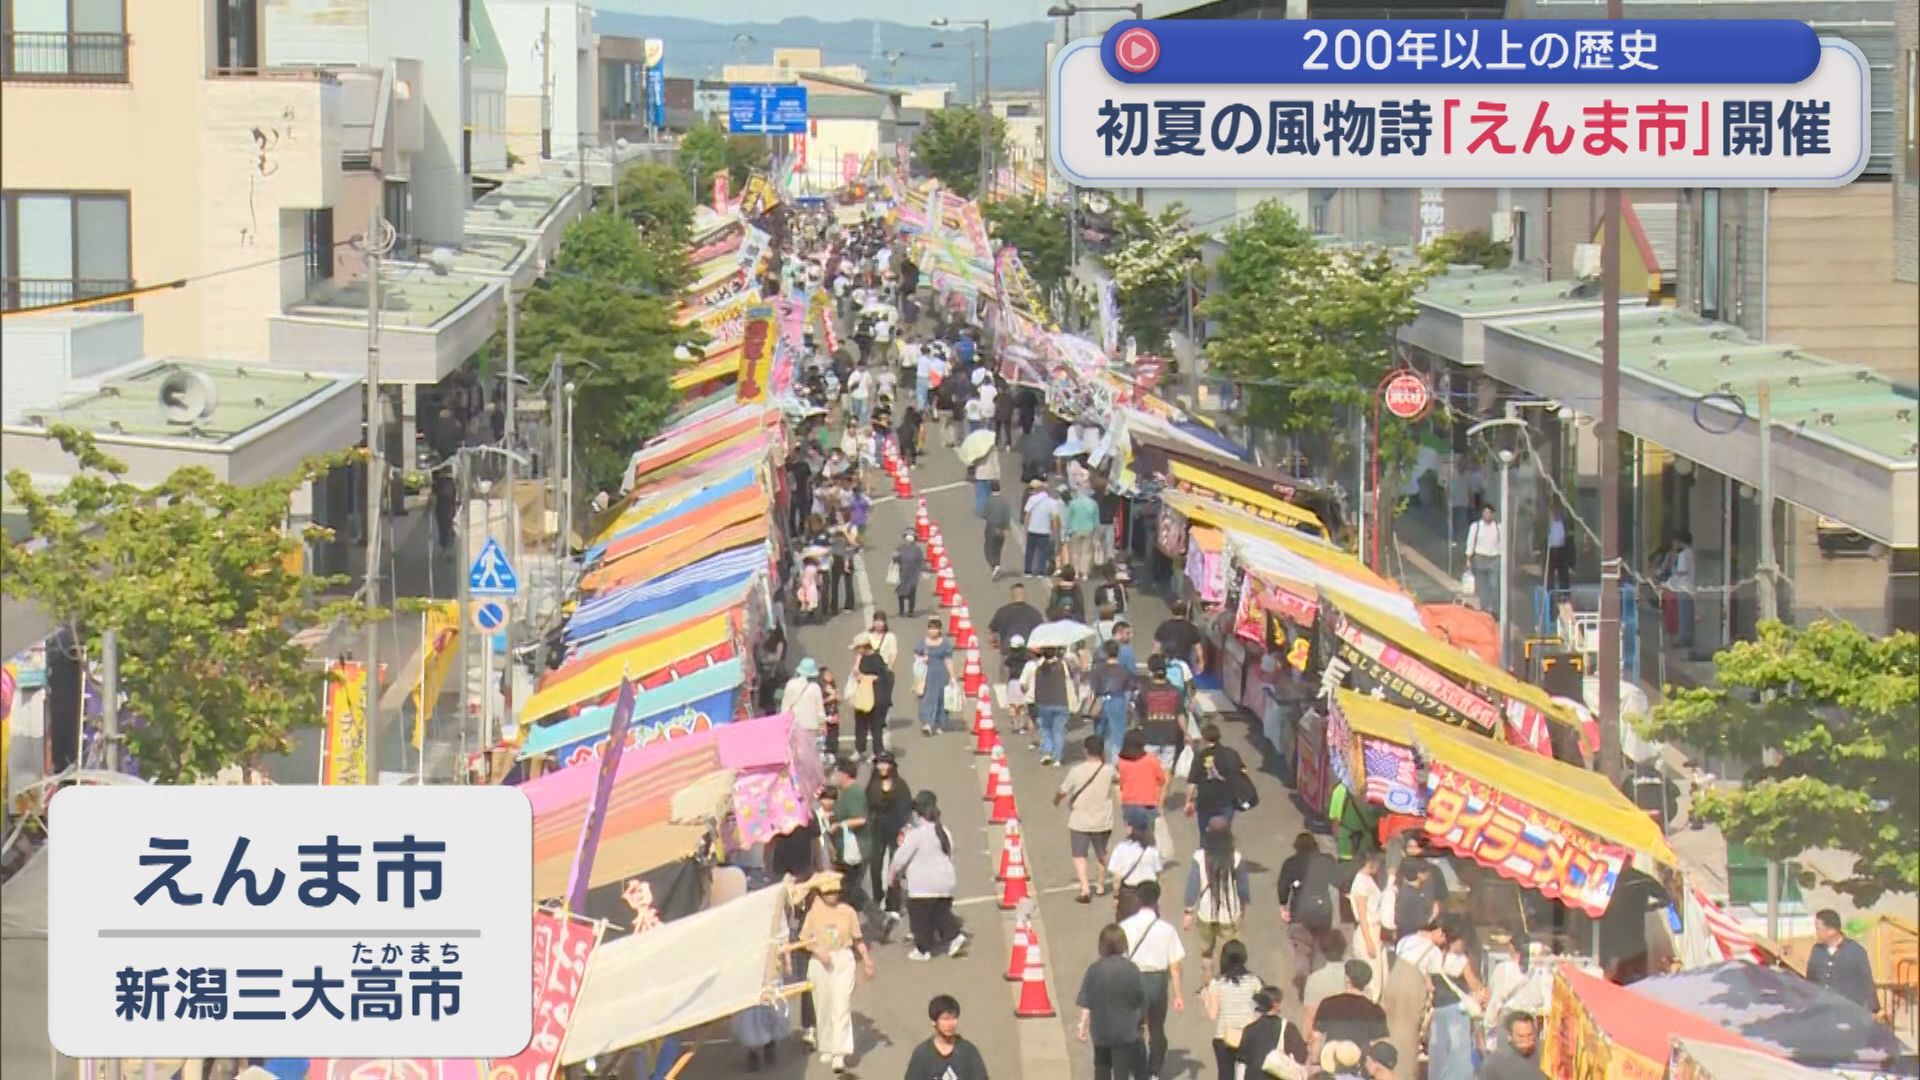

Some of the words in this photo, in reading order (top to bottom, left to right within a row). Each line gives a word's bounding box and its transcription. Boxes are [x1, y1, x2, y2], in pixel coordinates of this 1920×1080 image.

[1424, 786, 1610, 900] タイラーメン
